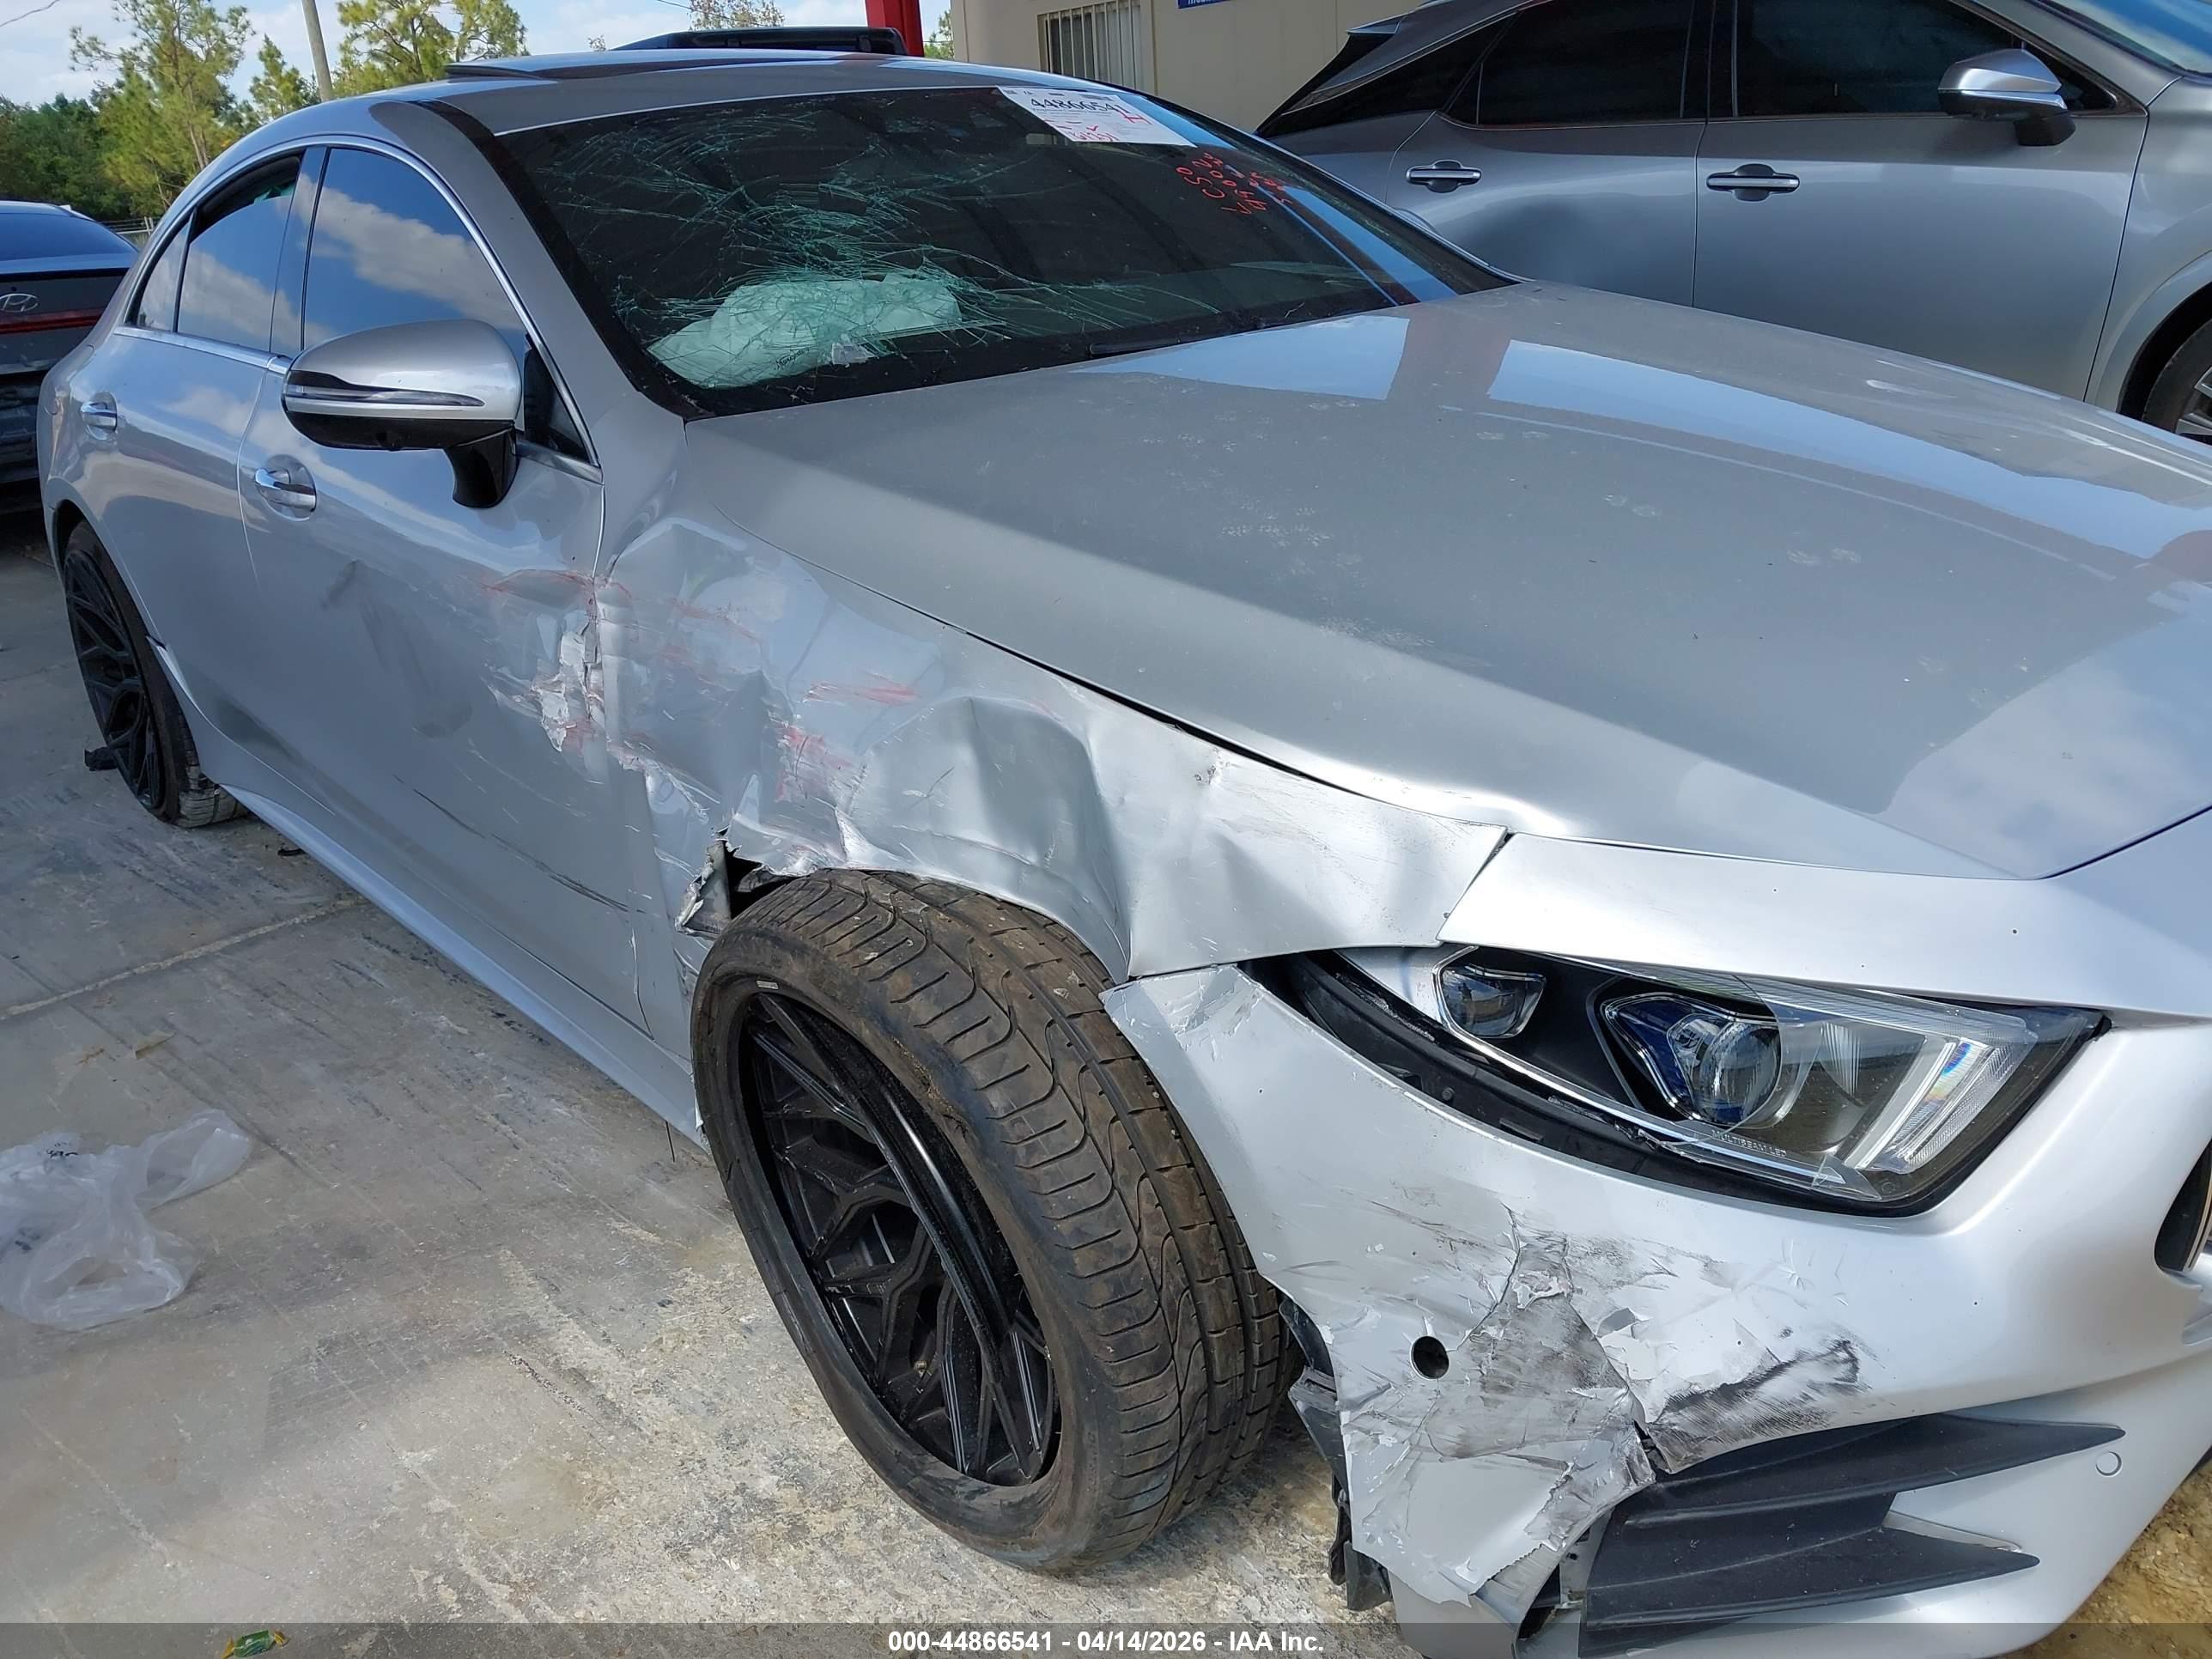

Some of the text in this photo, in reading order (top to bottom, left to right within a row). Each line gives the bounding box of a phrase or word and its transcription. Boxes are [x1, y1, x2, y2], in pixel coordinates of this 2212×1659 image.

[1030, 98, 1131, 113] 44866541
[1711, 1129, 1787, 1158] MULTIBEAM LED
